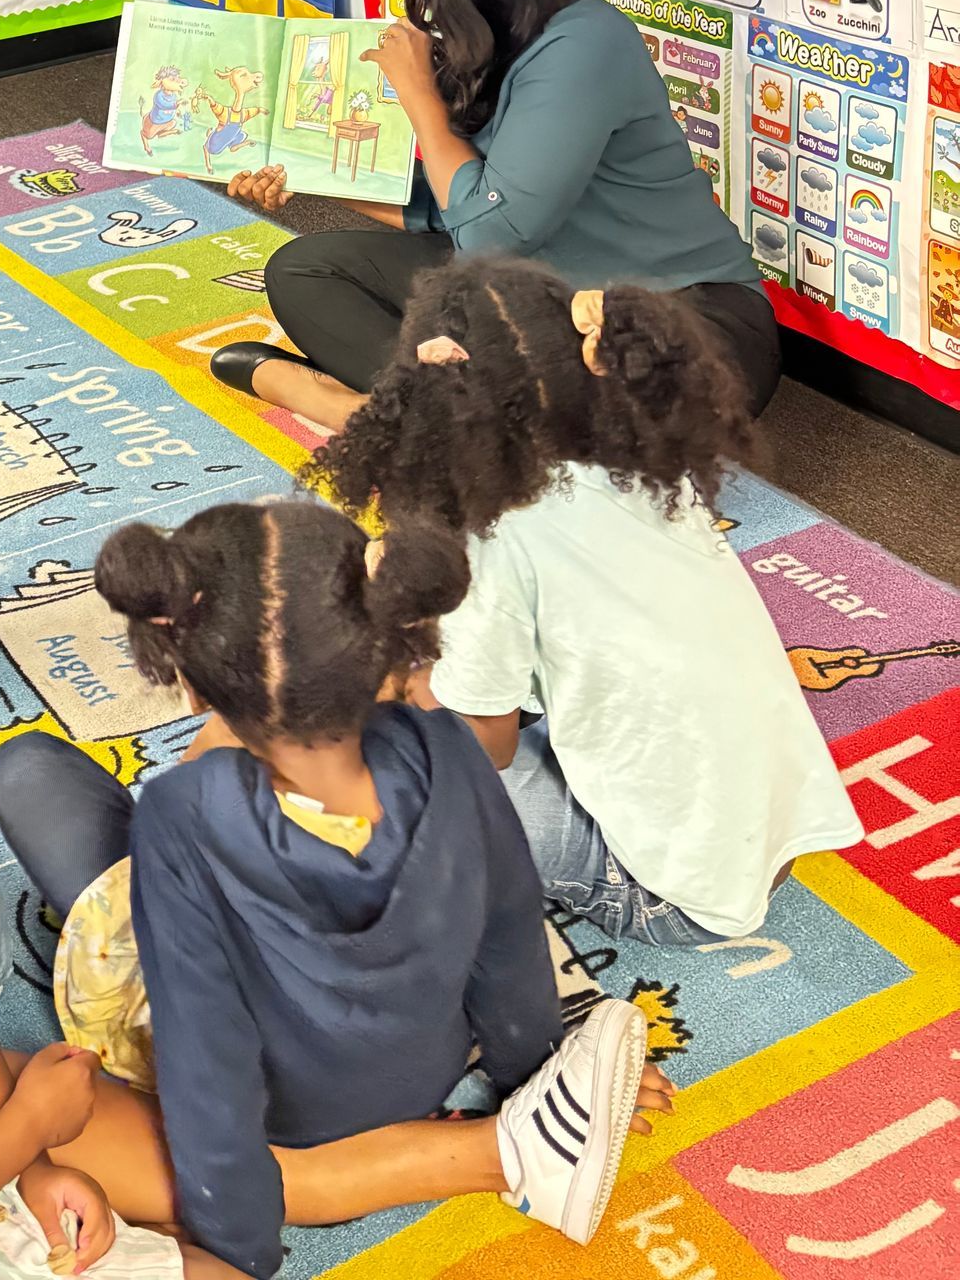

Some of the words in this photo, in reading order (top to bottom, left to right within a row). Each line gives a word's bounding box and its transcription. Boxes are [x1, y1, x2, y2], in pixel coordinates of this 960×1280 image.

[654, 1, 670, 20] of
[671, 7, 692, 29] the
[694, 8, 725, 38] Year
[809, 5, 827, 19] Zoo
[837, 14, 881, 33] Zucchini
[683, 52, 718, 72] February
[778, 30, 874, 84] Weather
[669, 82, 687, 96] April
[693, 125, 713, 138] June
[758, 119, 784, 138] Sunny
[798, 134, 817, 150] Partly
[817, 141, 838, 158] Sunny
[45, 141, 110, 176] alligator
[851, 154, 887, 175] Cloudy
[121, 184, 186, 220] bunny
[756, 190, 785, 213] Stormy
[804, 212, 828, 231] Rainy
[210, 234, 263, 261] cake
[846, 230, 887, 254] Rainbow
[758, 264, 782, 284] Foggy
[802, 285, 828, 305] Windy
[849, 306, 881, 329] Snowy
[43, 367, 199, 467] Spring
[751, 553, 888, 620] guitar
[36, 634, 119, 707] August
